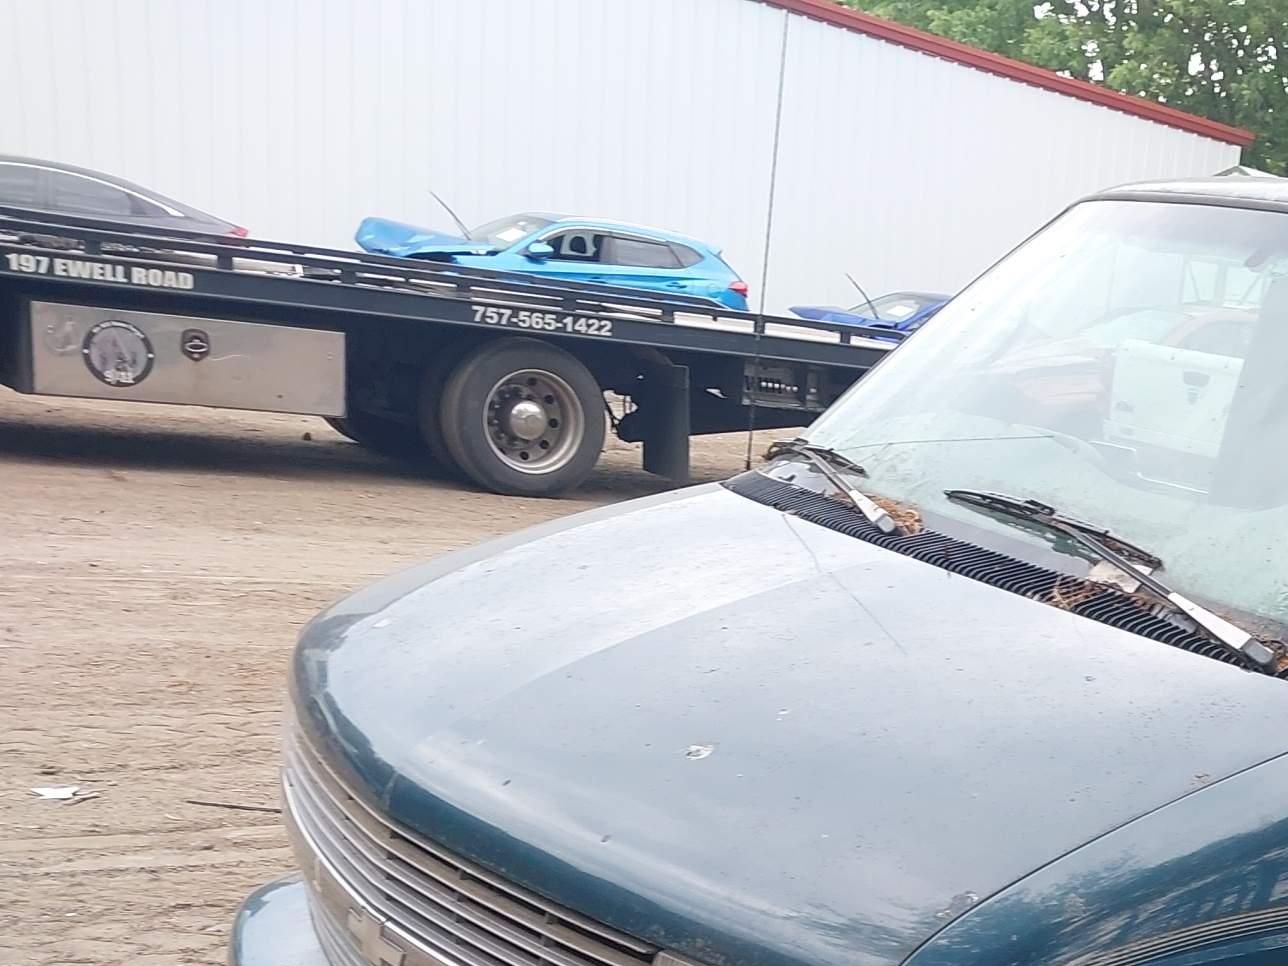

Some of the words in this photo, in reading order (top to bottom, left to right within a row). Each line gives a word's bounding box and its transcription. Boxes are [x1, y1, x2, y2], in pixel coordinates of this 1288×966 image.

[5, 253, 49, 274] 197
[53, 258, 128, 283] EWELL
[130, 266, 194, 290] ROAD
[471, 305, 612, 337] 757-565-1422
